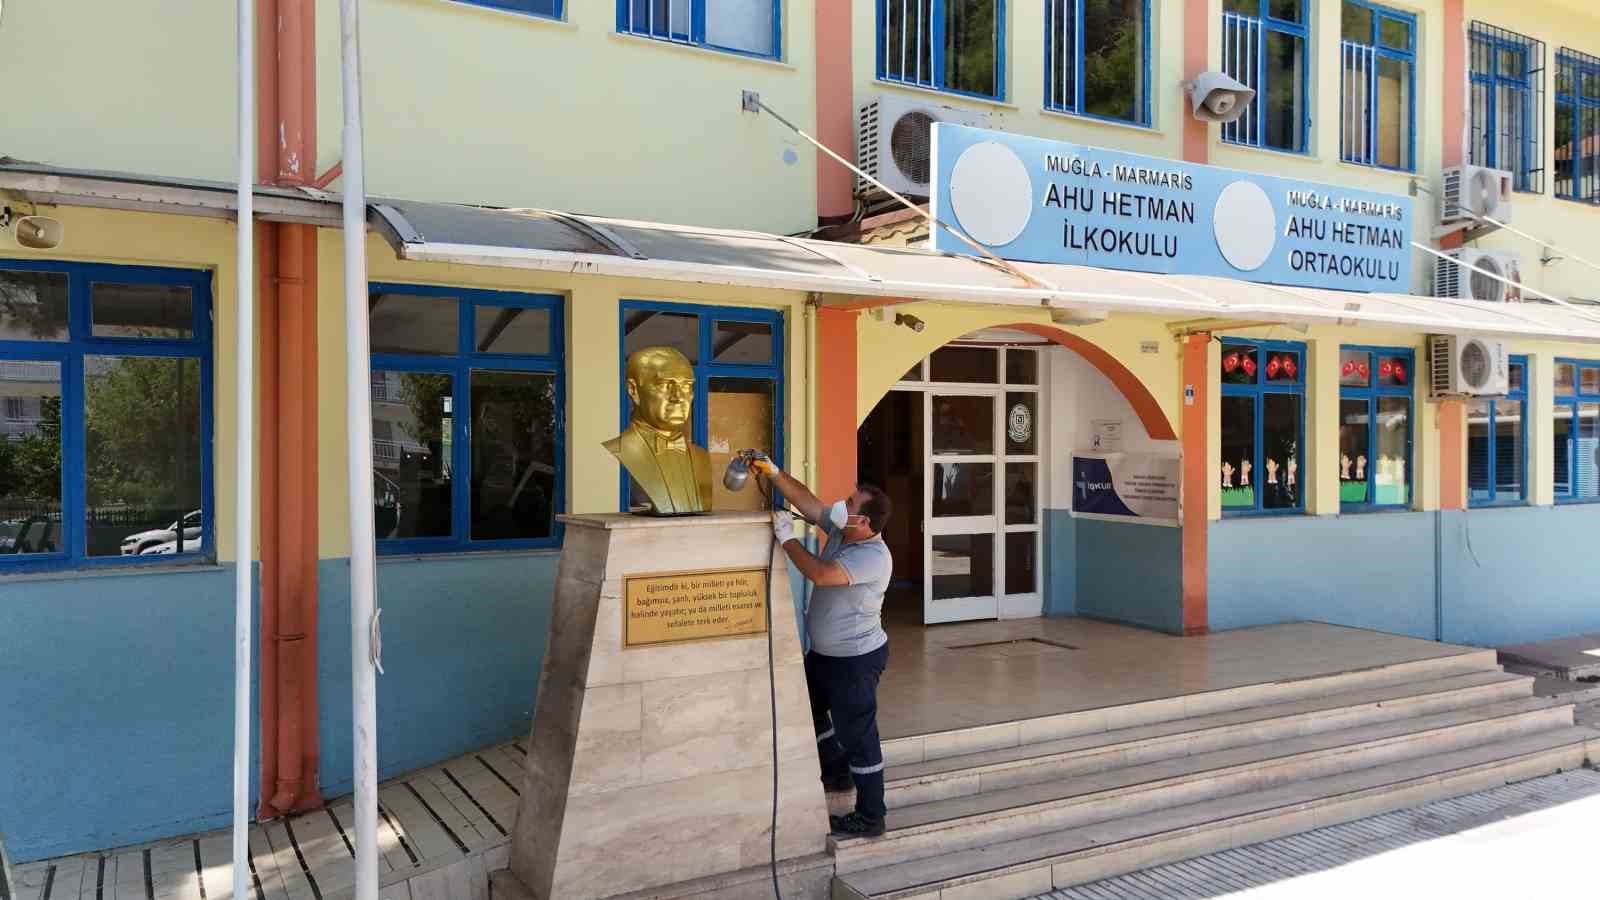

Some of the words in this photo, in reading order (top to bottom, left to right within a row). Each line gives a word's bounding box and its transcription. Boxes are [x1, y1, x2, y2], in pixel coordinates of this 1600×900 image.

[1046, 154, 1102, 178] MUĞLA
[1114, 165, 1193, 191] MARMARİS
[1044, 183, 1094, 212] AHU
[1102, 191, 1194, 224] HETMAN
[1288, 191, 1333, 210] MUĞLA
[1063, 218, 1177, 258] İLKOKULU
[1286, 215, 1326, 240] AHU
[1332, 222, 1403, 249] HETMAN
[1290, 249, 1399, 281] ORTAOKULU
